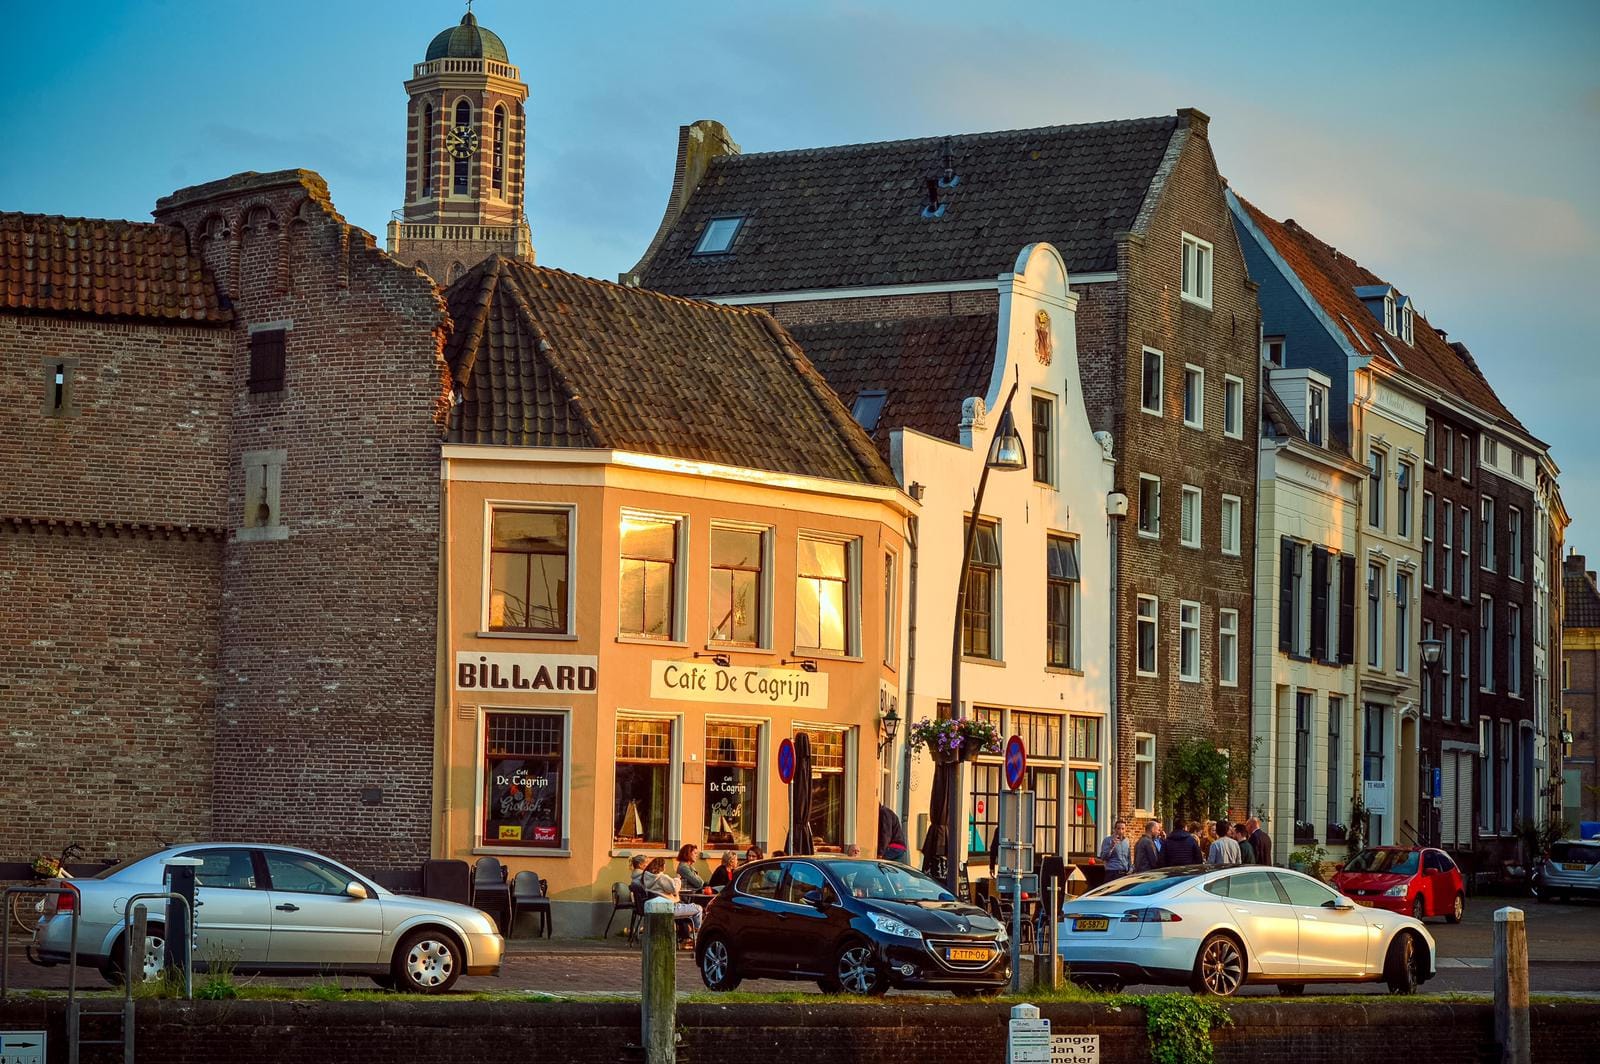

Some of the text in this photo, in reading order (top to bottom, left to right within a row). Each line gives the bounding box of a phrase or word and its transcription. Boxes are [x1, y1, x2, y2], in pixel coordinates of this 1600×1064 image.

[663, 665, 810, 702] Café De Tagrijn
[496, 775, 548, 788] De Tagrijn
[710, 782, 746, 794] De Tagrijn
[953, 950, 986, 960] 7-TTP-06
[1081, 1045, 1095, 1054] 12
[1051, 1056, 1092, 1064] meter
